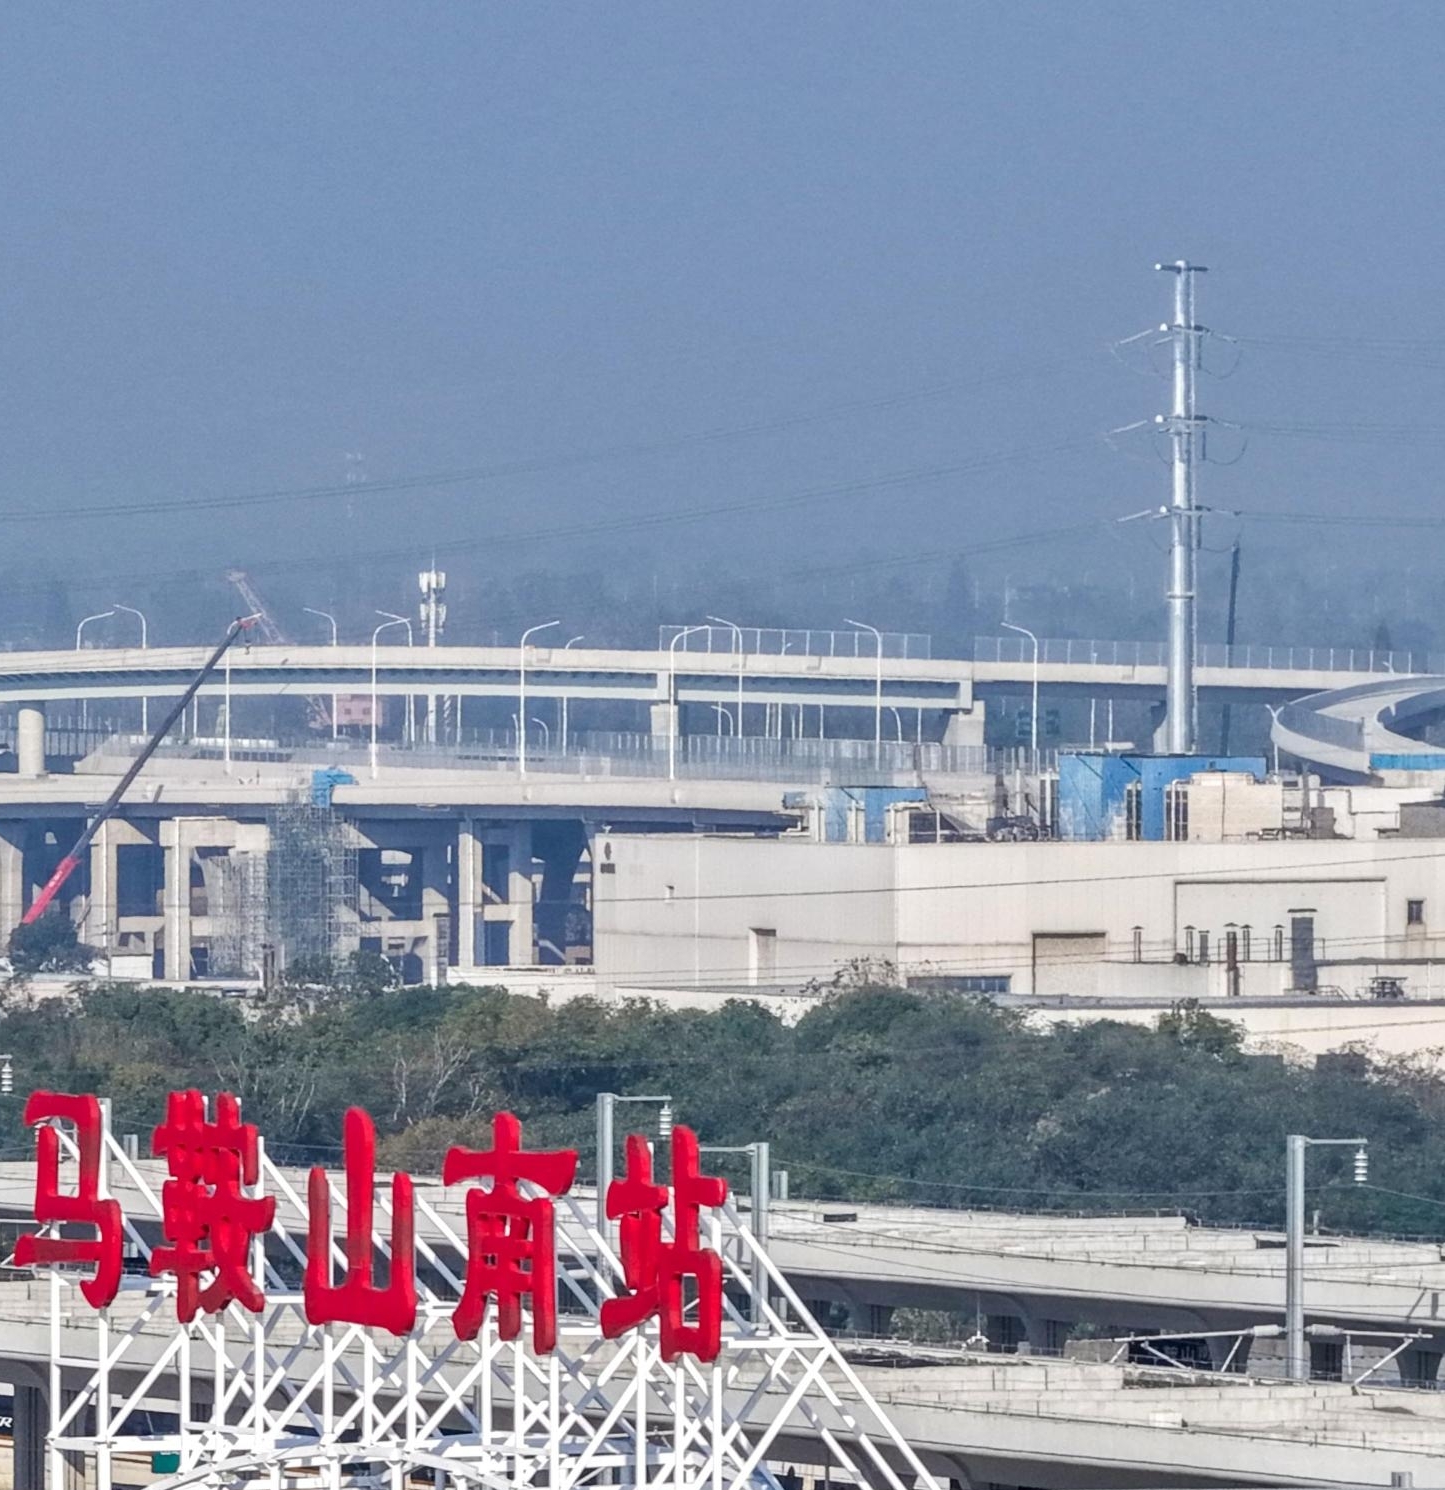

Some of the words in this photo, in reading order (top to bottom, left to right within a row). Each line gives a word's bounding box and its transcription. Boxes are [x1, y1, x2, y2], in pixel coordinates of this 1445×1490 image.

[13, 1090, 727, 1362] 马鞍山南站
